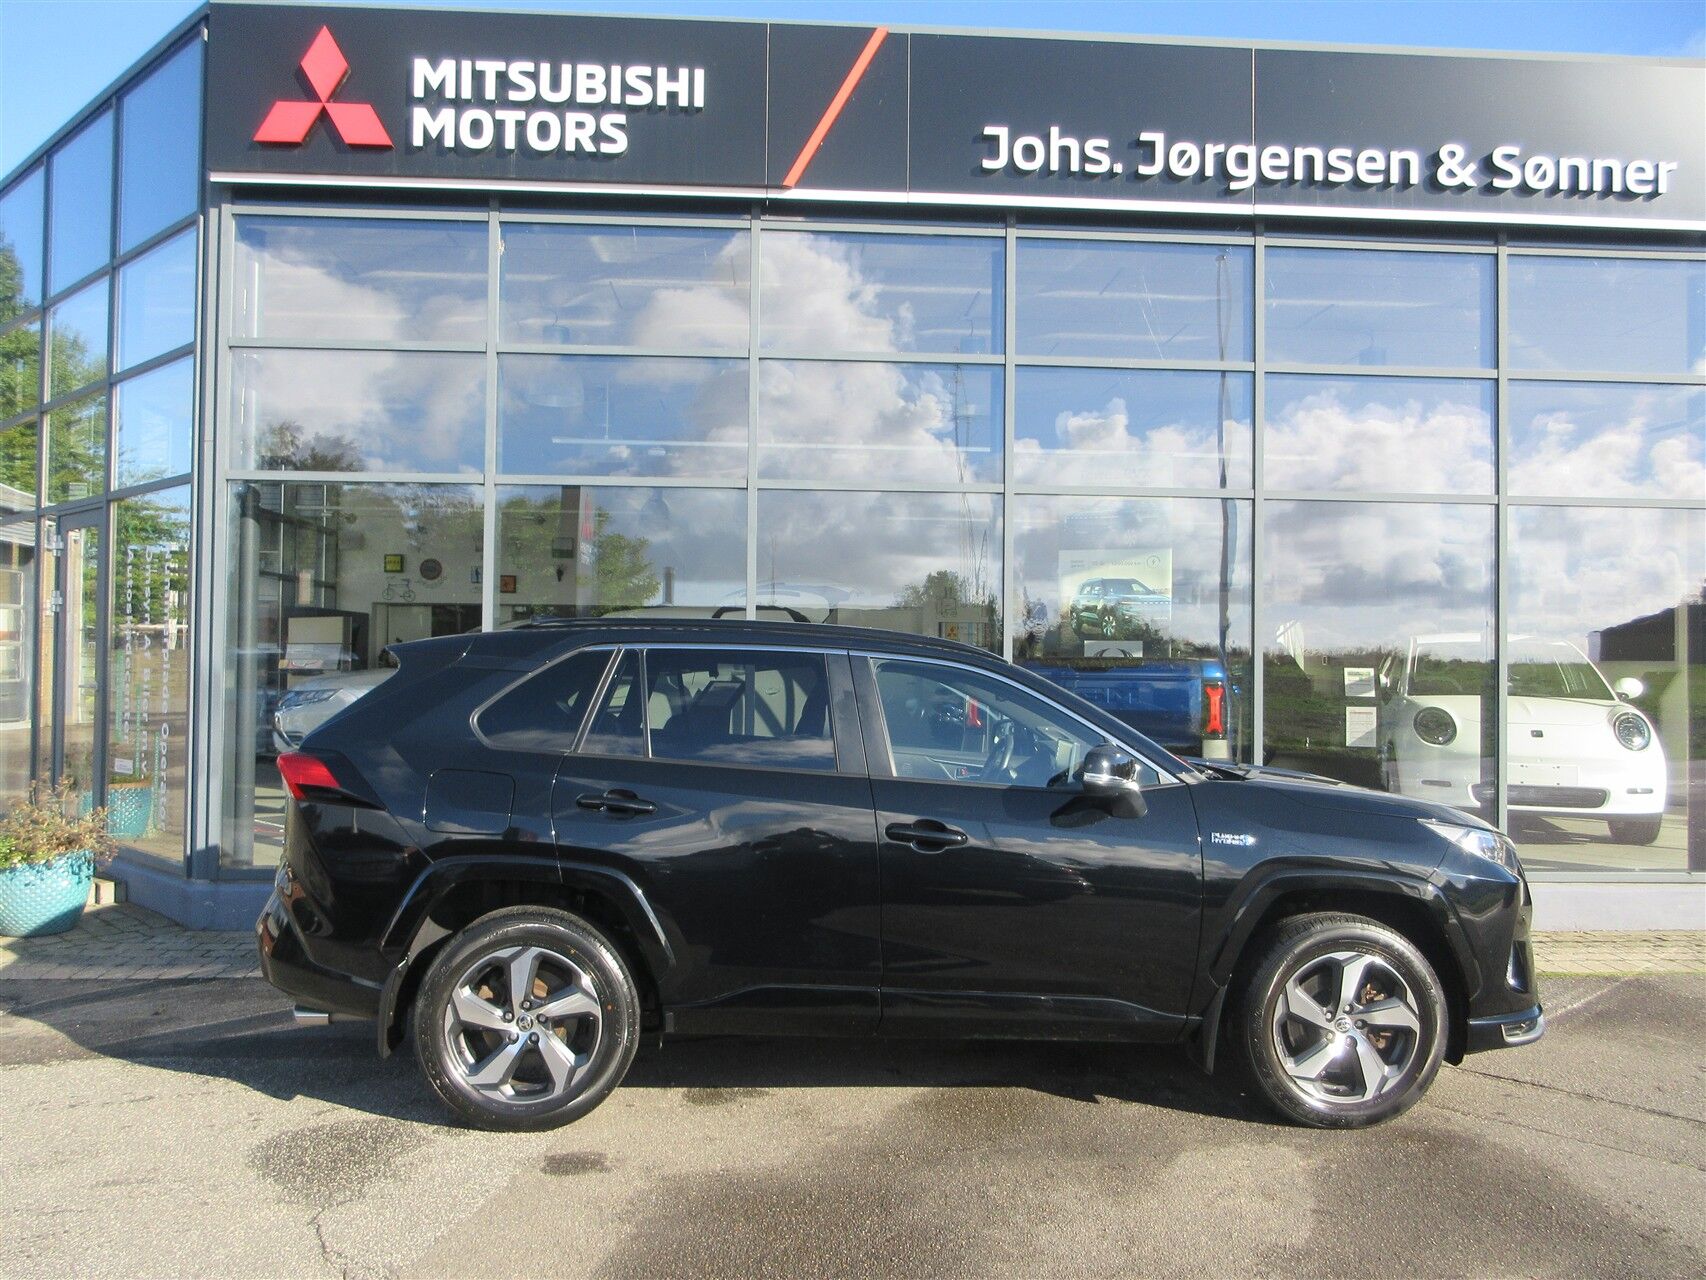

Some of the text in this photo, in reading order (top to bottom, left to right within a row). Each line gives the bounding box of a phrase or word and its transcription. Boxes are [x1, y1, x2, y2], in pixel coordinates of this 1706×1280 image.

[412, 58, 705, 108] MITSUBISHI
[412, 107, 628, 154] MOTORS
[981, 126, 1678, 194] Johs. Jørgensen & Sønner
